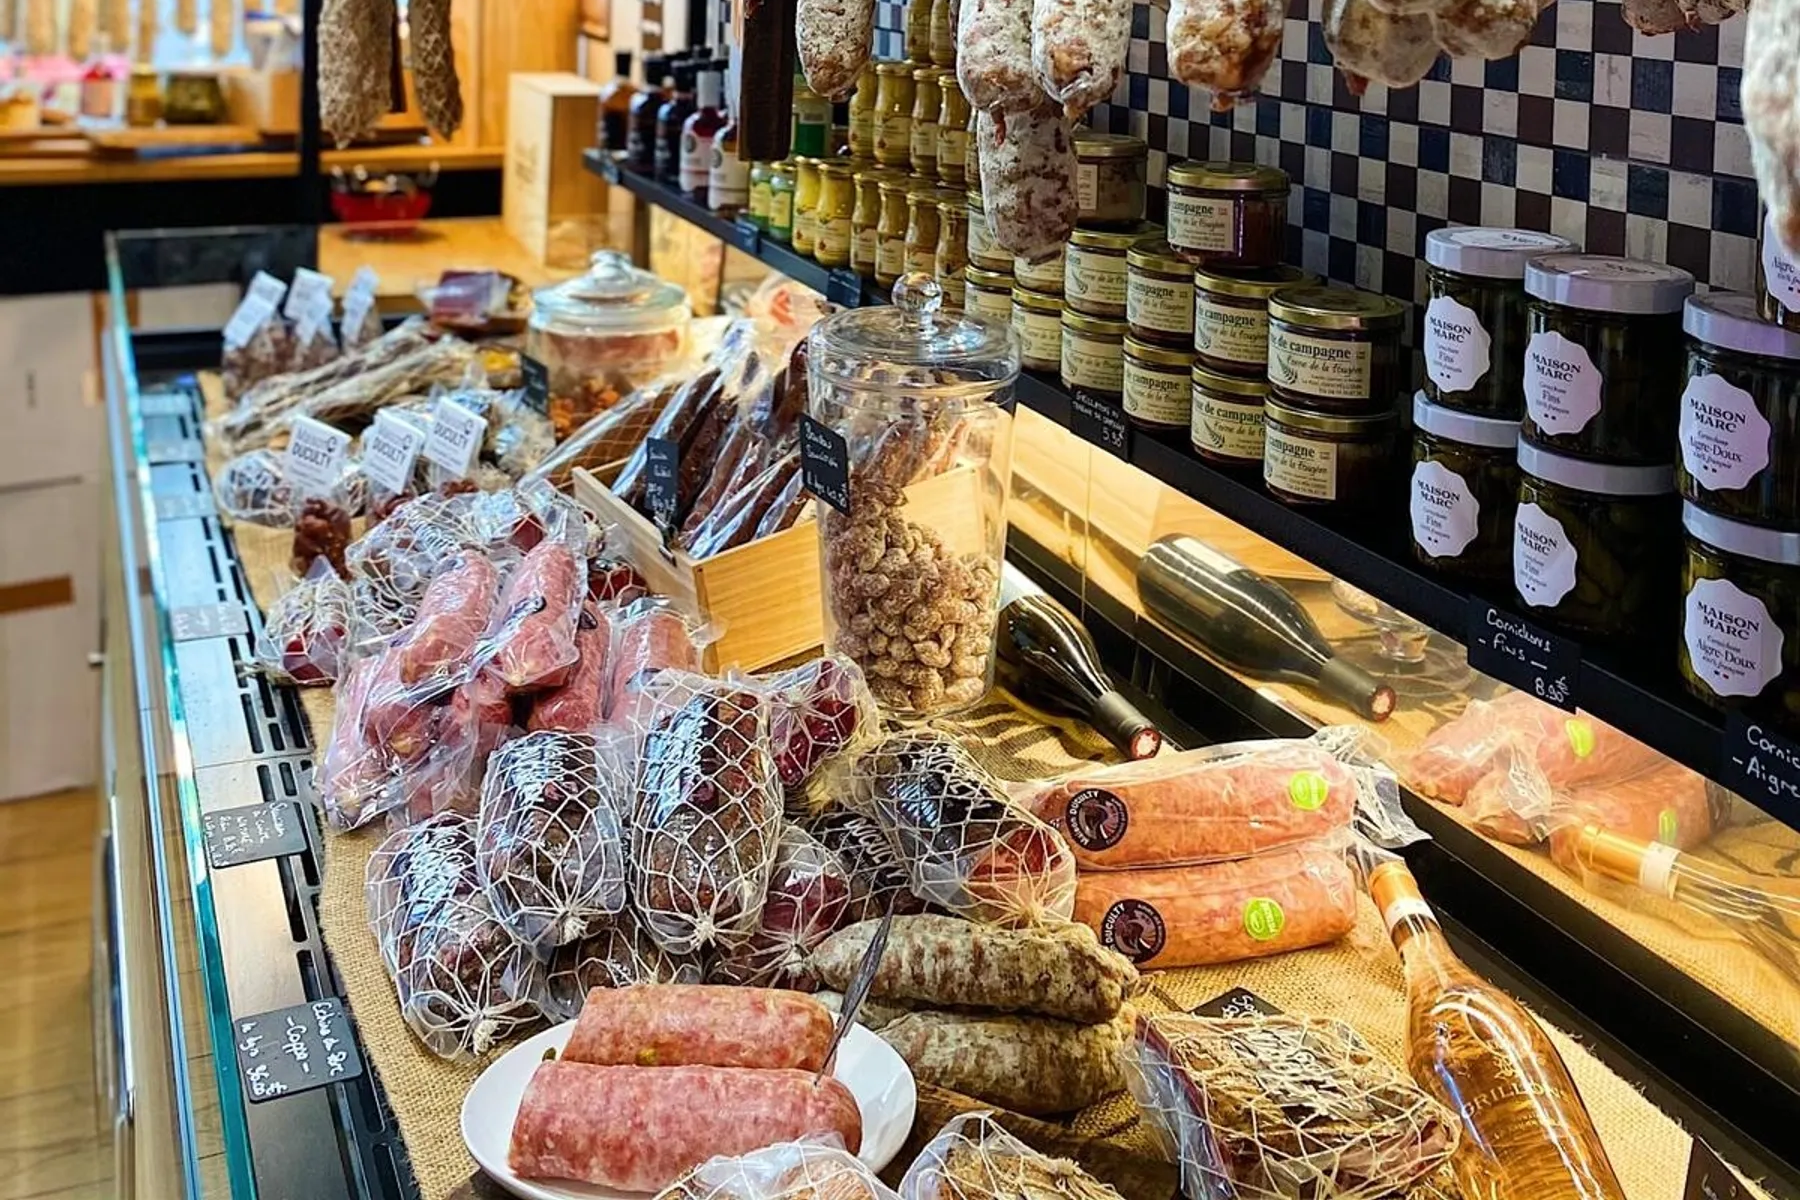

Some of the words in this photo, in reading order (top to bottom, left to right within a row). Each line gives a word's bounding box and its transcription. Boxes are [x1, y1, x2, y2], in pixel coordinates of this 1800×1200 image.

[1204, 310, 1256, 327] campagne
[1430, 315, 1472, 336] MAISON
[1433, 327, 1466, 343] MARC
[1289, 341, 1352, 361] campagne
[1532, 352, 1581, 374] MAISON
[1133, 375, 1180, 391] campagne
[1536, 364, 1573, 382] MARC
[1689, 398, 1746, 424] MAISON
[1695, 411, 1737, 433] MARC
[434, 421, 469, 449] DUCULTY
[292, 442, 333, 468] DUCULTY
[372, 435, 407, 467] DUCULTY
[1417, 479, 1461, 502] MAISON
[1420, 491, 1454, 509] MARC
[1517, 522, 1558, 548] MAISON
[1520, 534, 1551, 556] MARC
[1697, 600, 1760, 633] MAISON
[1703, 615, 1751, 641] MARC
[1486, 608, 1551, 653] Cornichons
[1697, 638, 1757, 671] Aigre-Doux
[1746, 724, 1800, 770] Cornic
[1069, 790, 1100, 816] DUCULTY
[1105, 902, 1127, 945] DUCULTY
